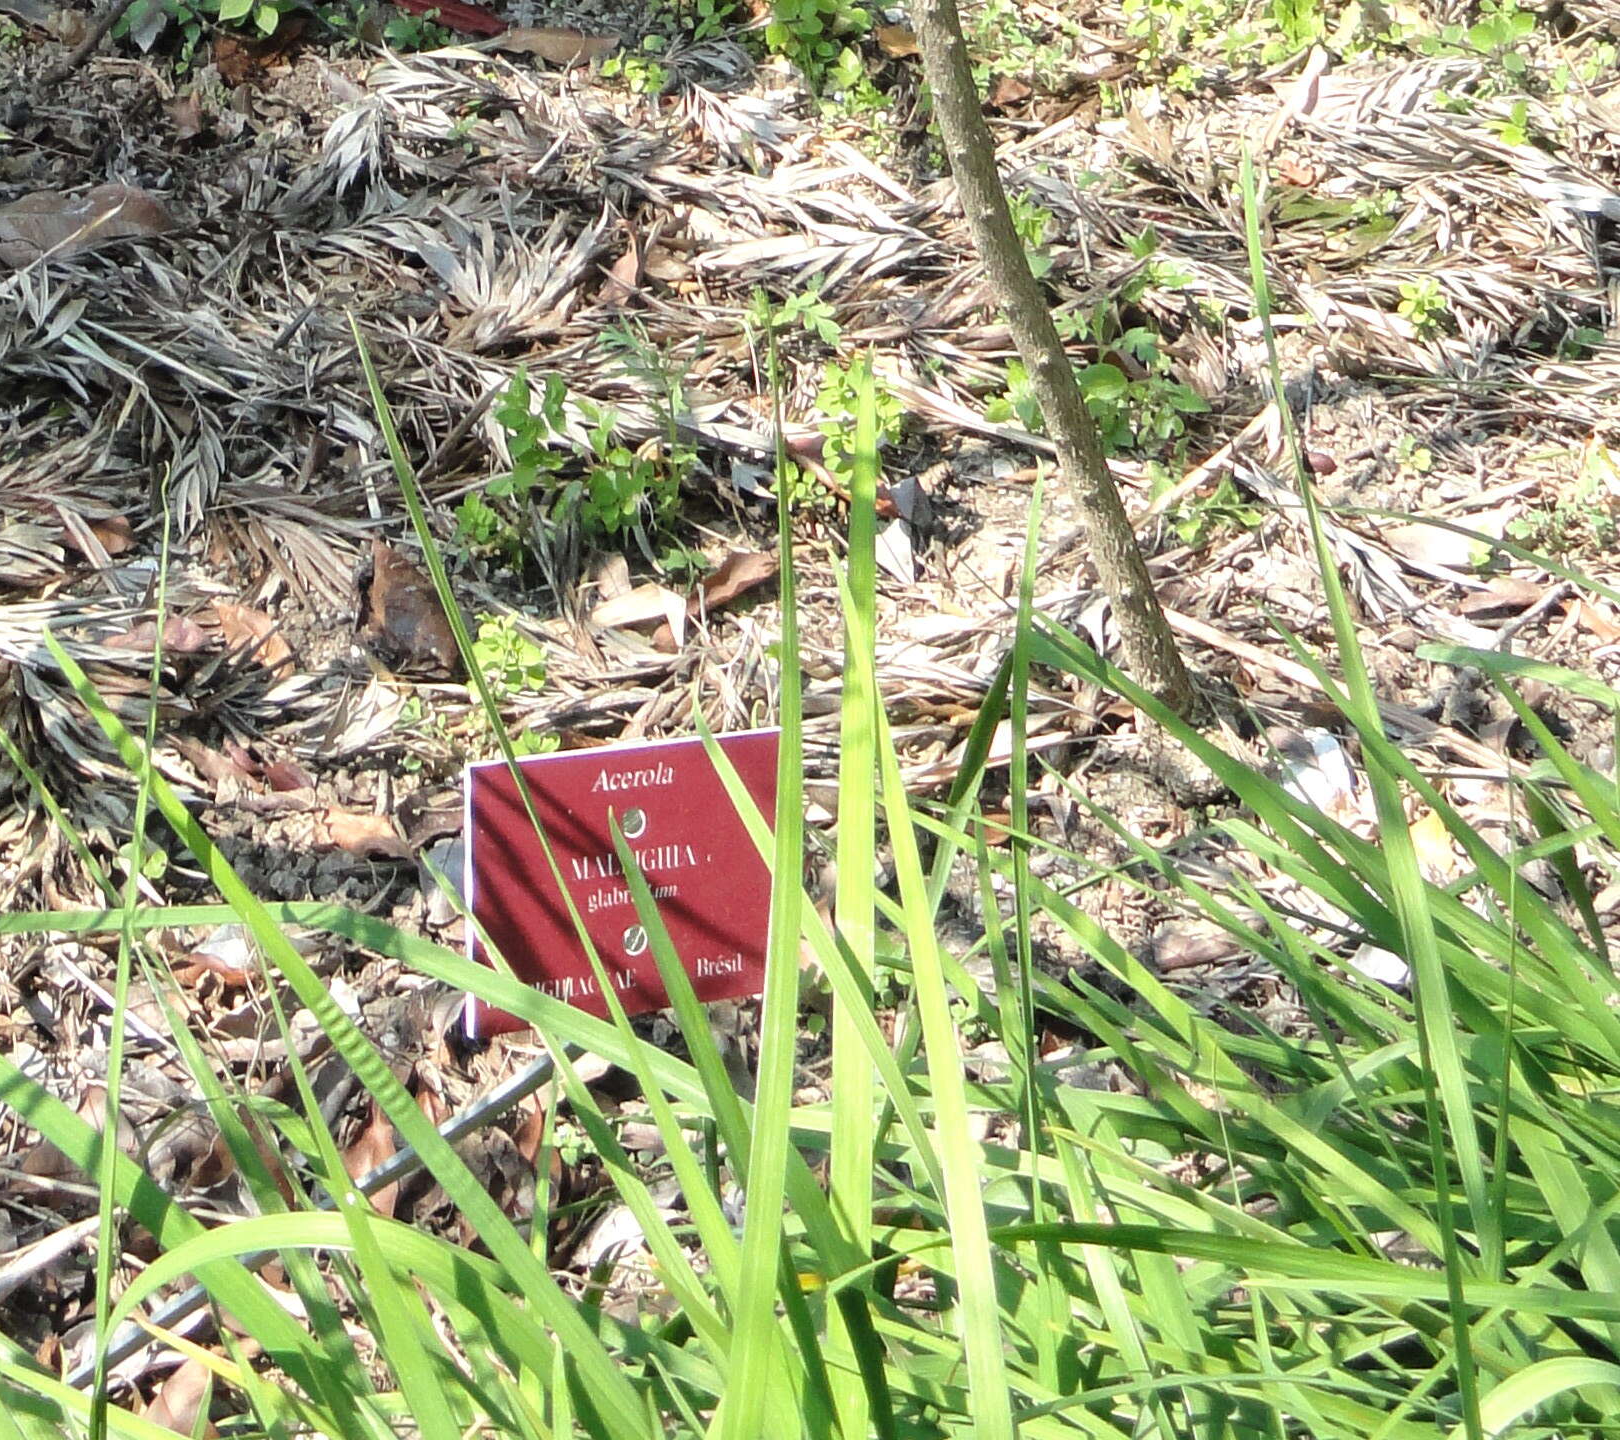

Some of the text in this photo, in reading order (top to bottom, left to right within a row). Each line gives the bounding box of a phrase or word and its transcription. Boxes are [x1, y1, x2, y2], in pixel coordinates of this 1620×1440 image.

[591, 761, 674, 793] Acerola
[571, 844, 697, 881] MALIGHIA
[587, 886, 636, 913] glabr
[697, 952, 743, 977] Brésil
